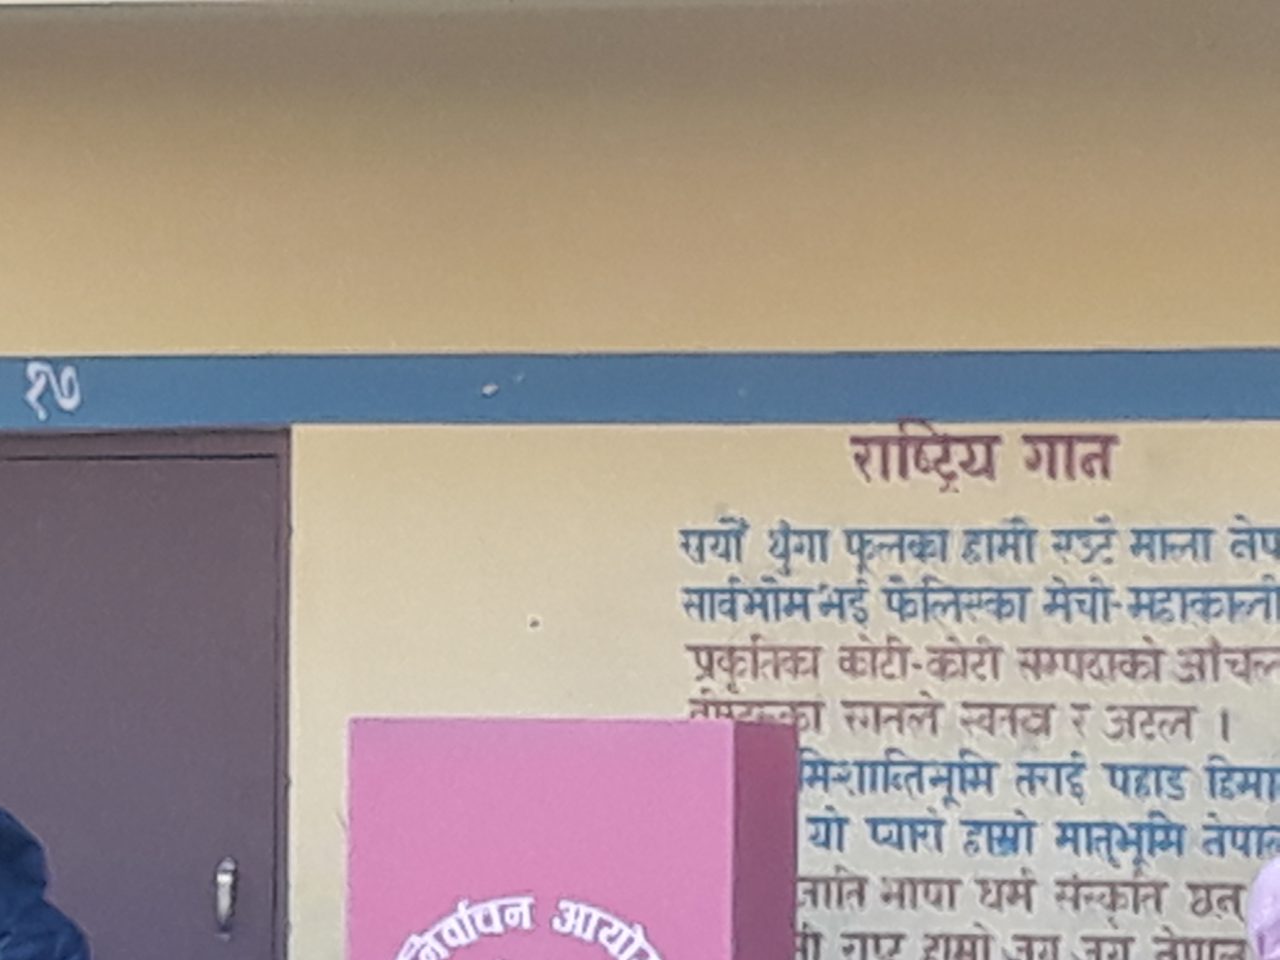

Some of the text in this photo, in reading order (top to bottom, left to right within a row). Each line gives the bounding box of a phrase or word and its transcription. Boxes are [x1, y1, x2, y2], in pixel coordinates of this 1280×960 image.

[850, 418, 1119, 493] राष्ट्रिय गान
[961, 516, 1038, 563] हामी
[1130, 528, 1216, 561] माला
[1070, 702, 1091, 736] र
[1105, 704, 1198, 741] अटल
[806, 804, 850, 852] यो
[865, 806, 946, 853] प्यारो
[959, 808, 1038, 856] हाम्रो
[1055, 809, 1187, 869] मातृभूमि
[974, 866, 1037, 913] धर्म
